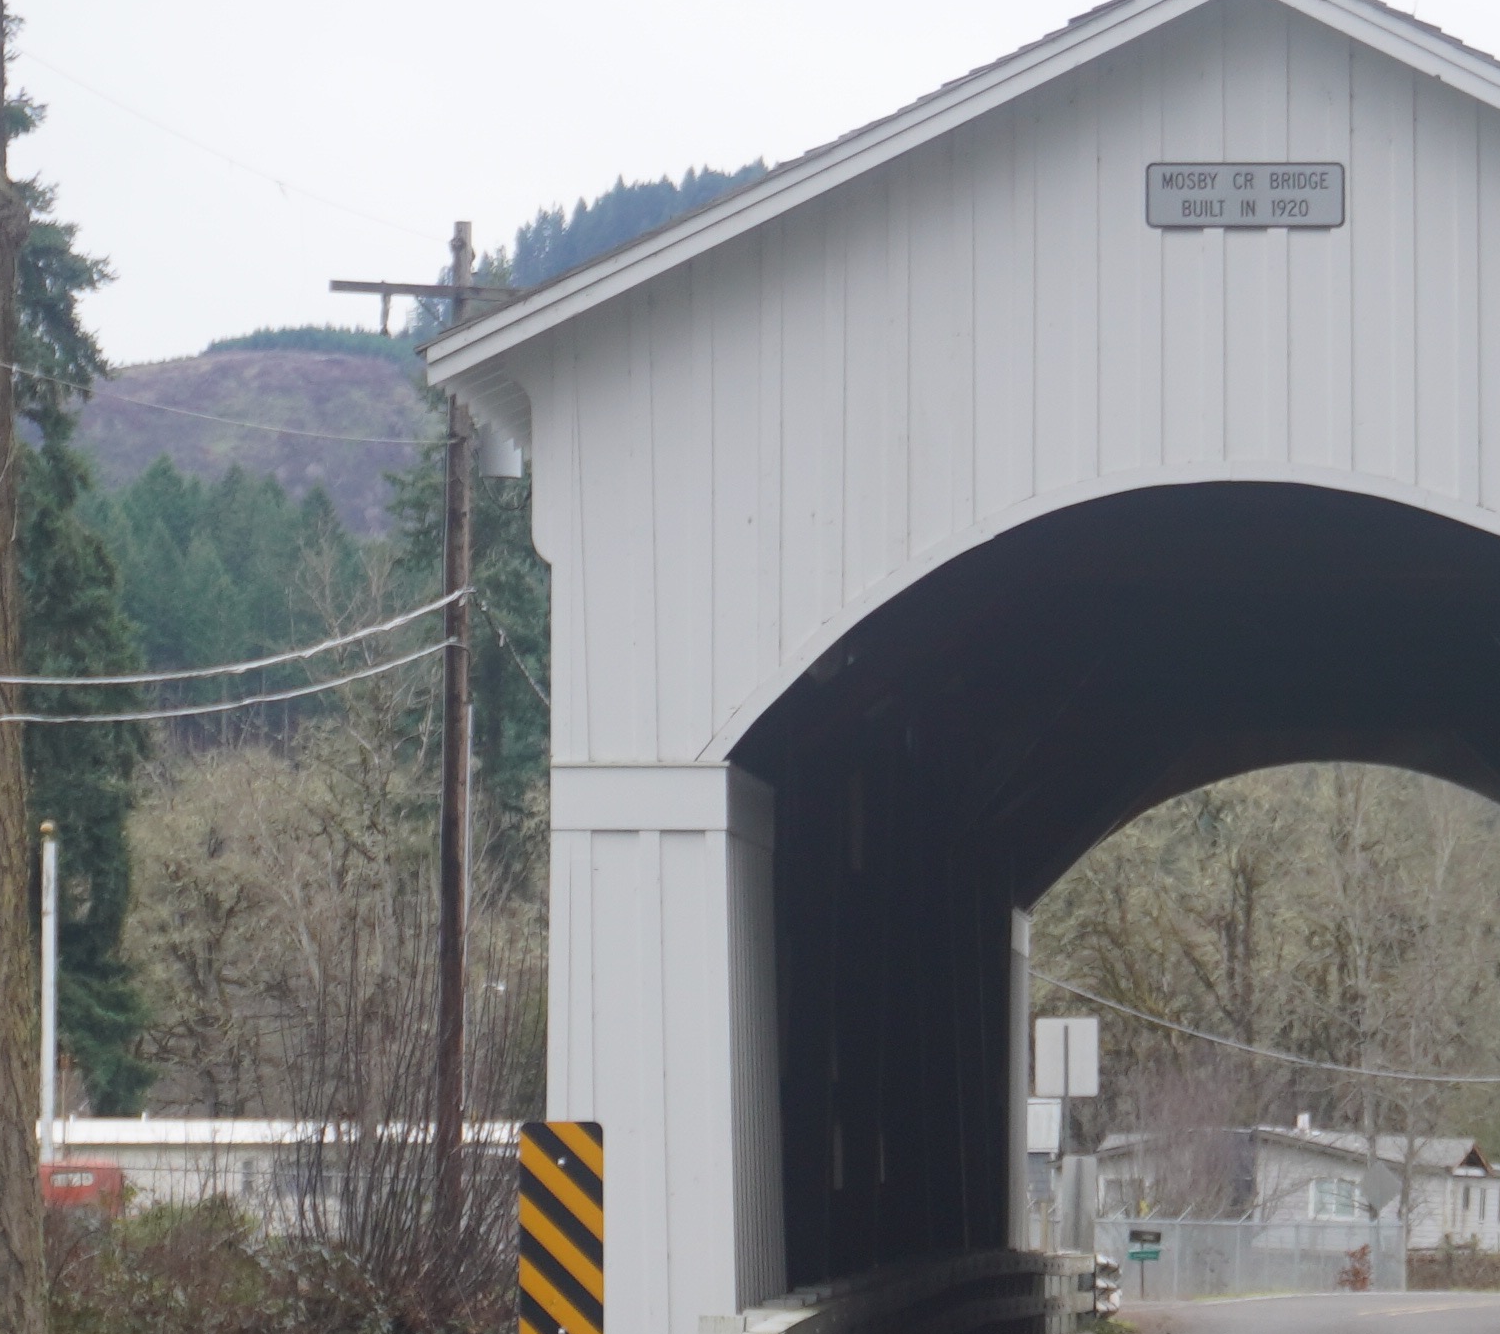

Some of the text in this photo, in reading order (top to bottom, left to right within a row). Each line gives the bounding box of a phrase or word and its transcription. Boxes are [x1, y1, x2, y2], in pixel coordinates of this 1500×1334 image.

[1161, 172, 1329, 190] MOSBY CR BRIDGE
[1181, 199, 1309, 217] BUILT IN 1920
